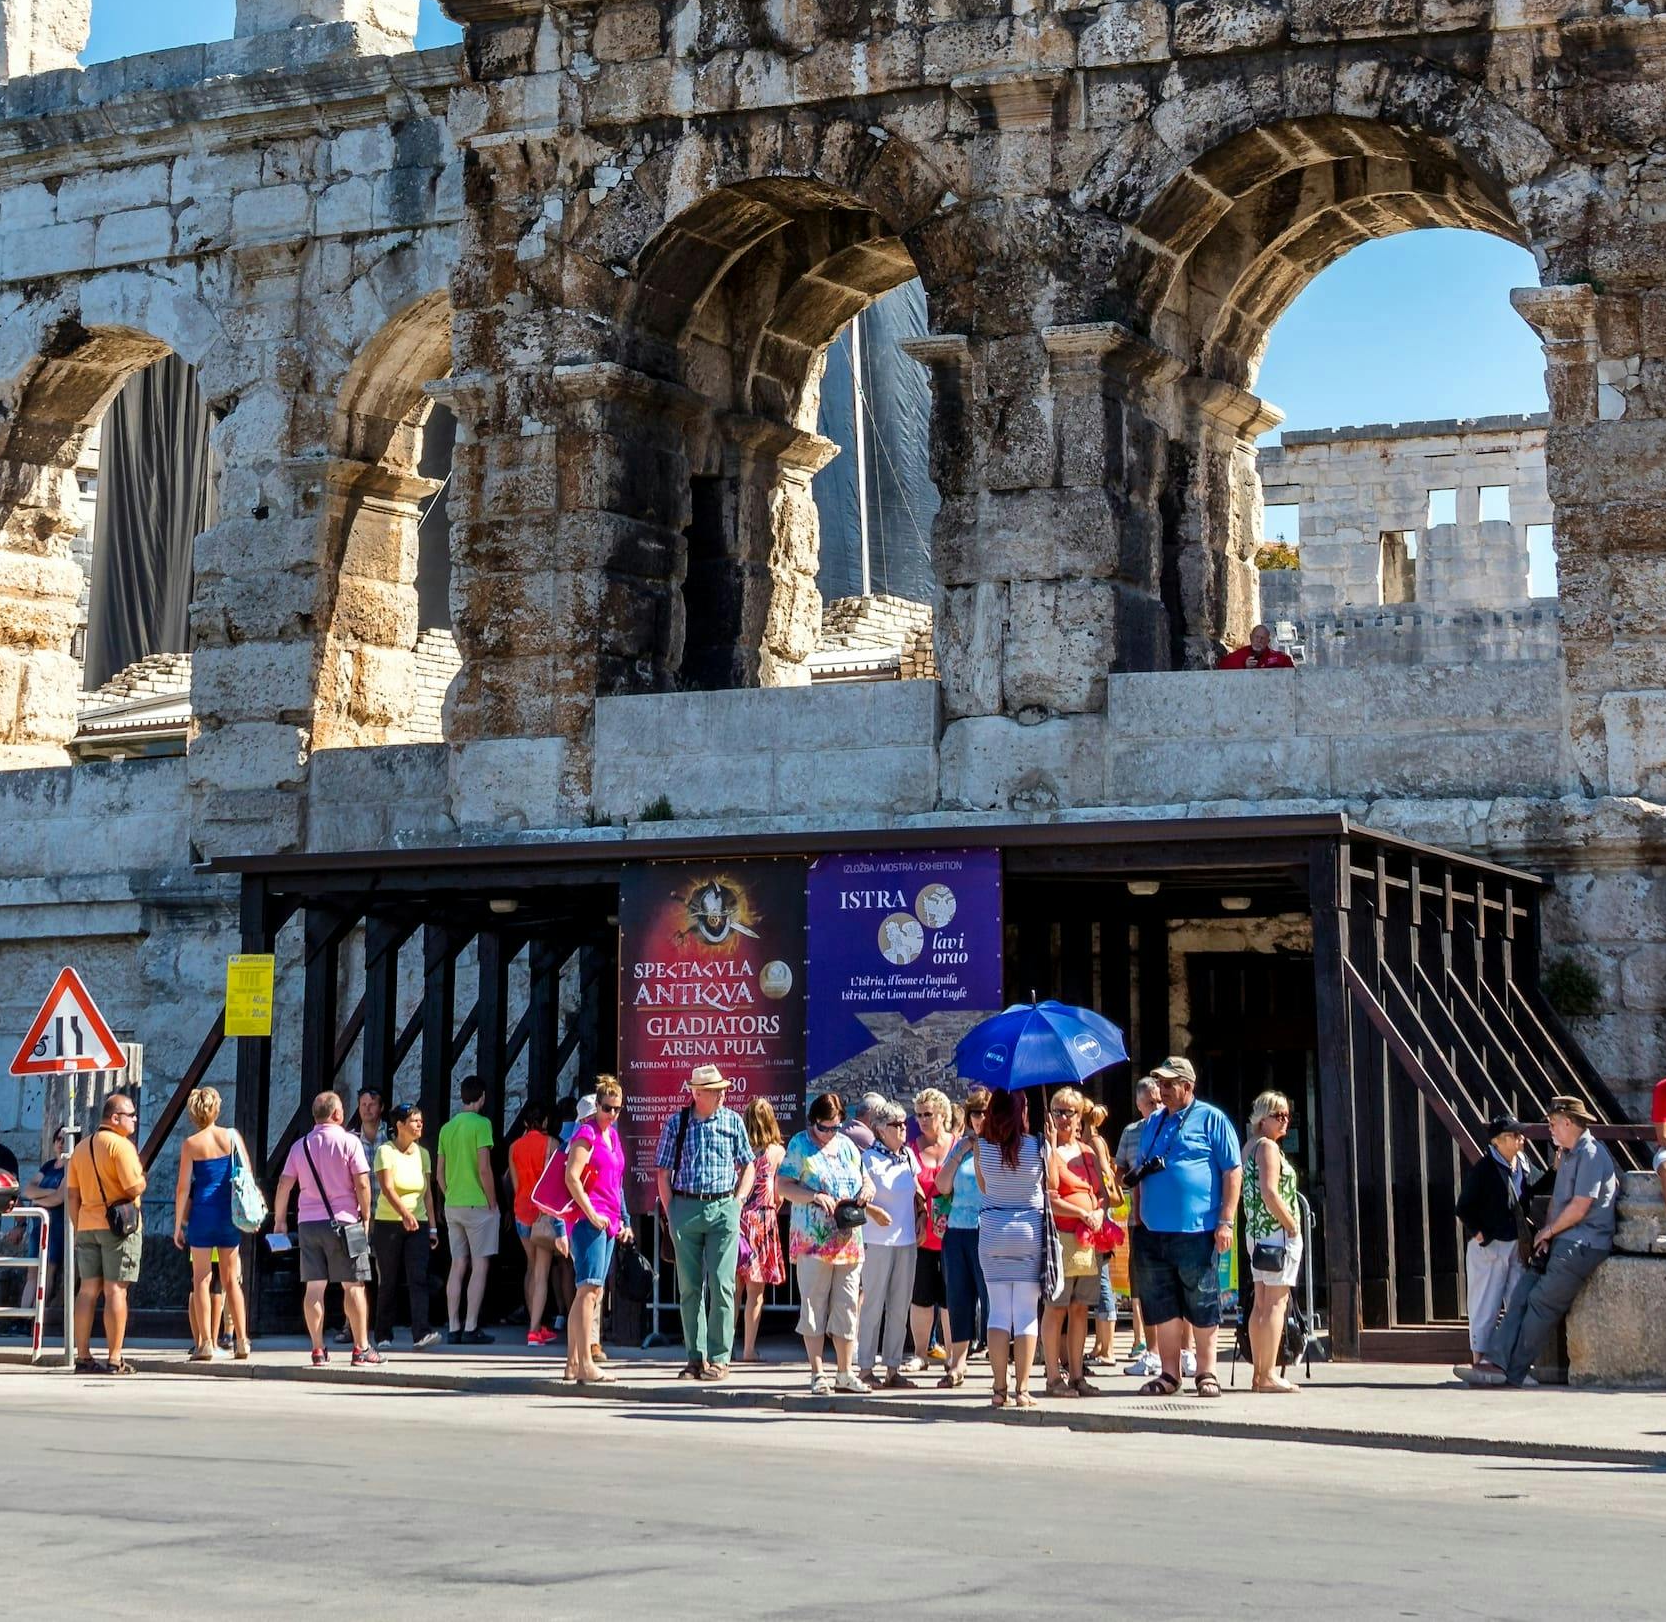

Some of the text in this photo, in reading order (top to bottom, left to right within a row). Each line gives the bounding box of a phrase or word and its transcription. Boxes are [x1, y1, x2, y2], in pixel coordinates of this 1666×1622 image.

[880, 862, 913, 872] MOSTRA
[919, 861, 962, 871] EXHIBITION
[840, 890, 908, 909] ISTRA
[933, 952, 968, 964] orao
[919, 977, 924, 985] e
[633, 981, 754, 1012] ANTIQVA
[842, 986, 967, 1001] Istria, the Lion and the Eagle
[647, 1015, 780, 1036] GLADIATORS
[660, 1039, 766, 1056] ARENA PULA
[986, 1052, 1004, 1063] NIVEA
